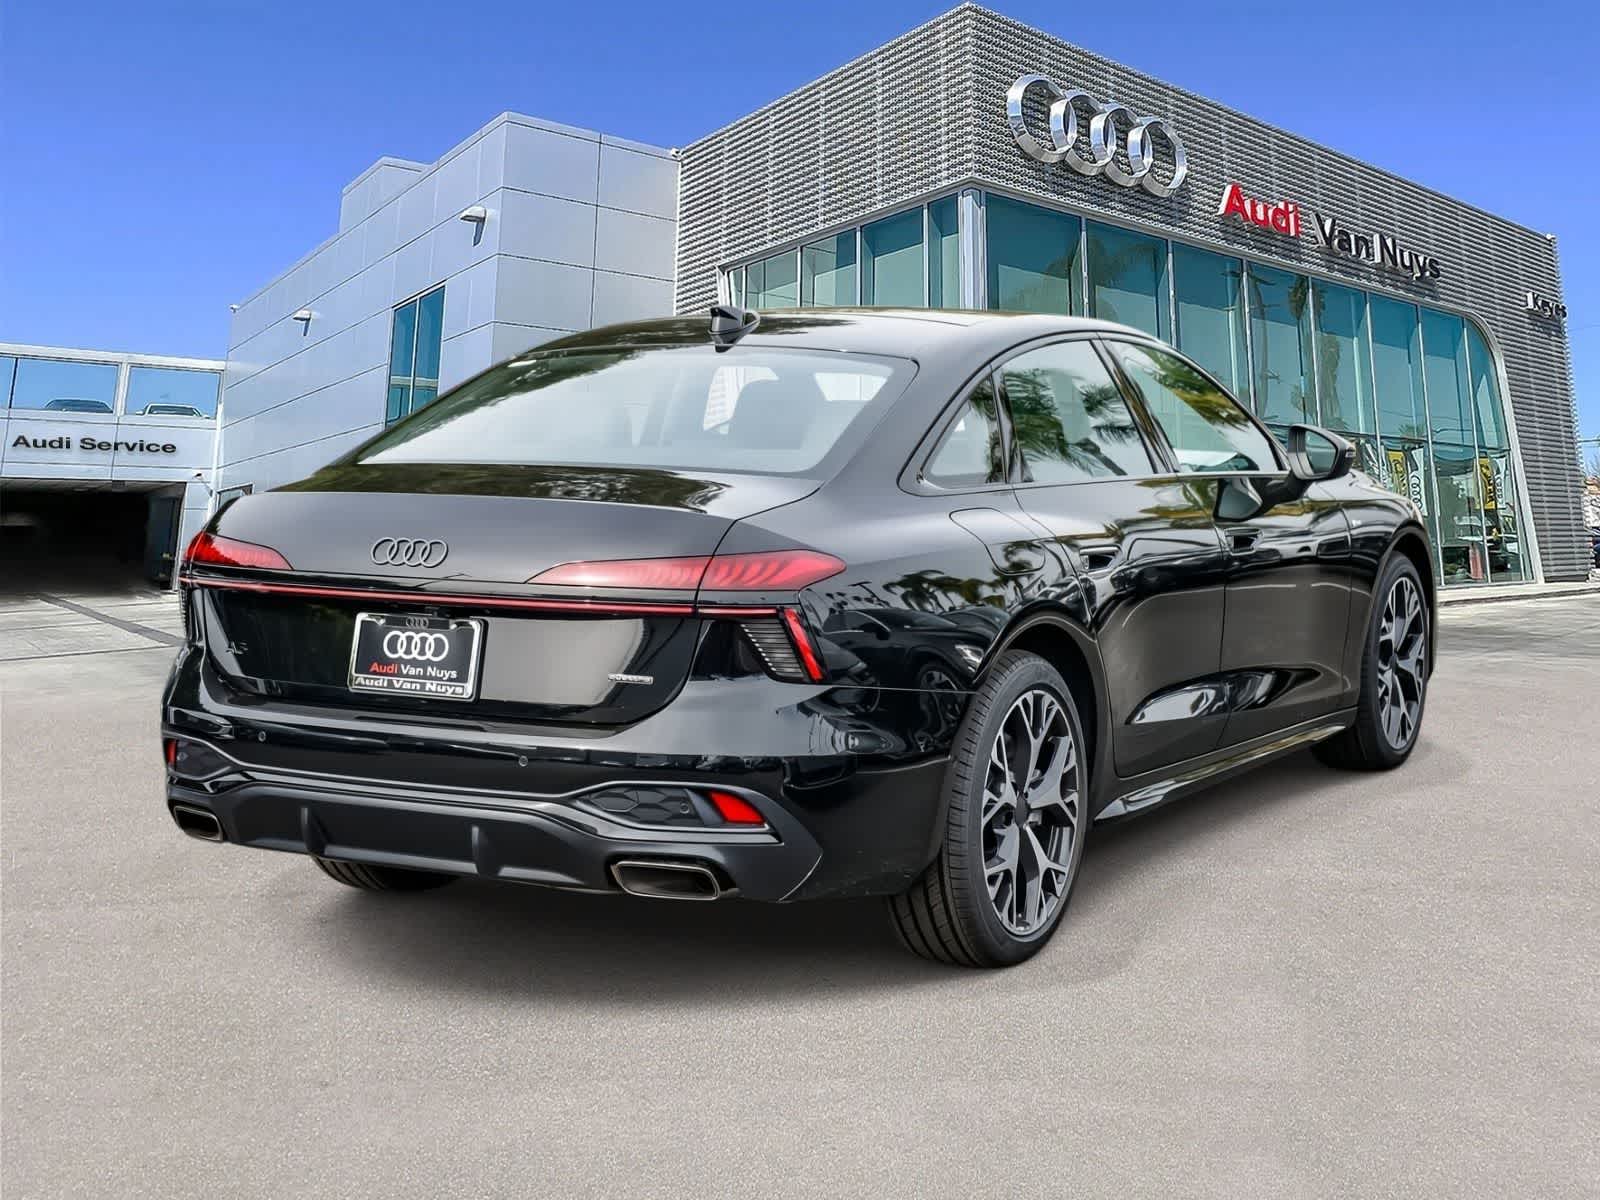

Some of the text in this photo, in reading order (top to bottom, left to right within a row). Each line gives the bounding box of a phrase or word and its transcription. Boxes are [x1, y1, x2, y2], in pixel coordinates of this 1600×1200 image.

[1218, 182, 1441, 281] Audi Van Nuys
[12, 435, 177, 454] Audi Service
[370, 662, 457, 680] Audi Van Nuys
[355, 677, 464, 695] Audi Van Nuys
